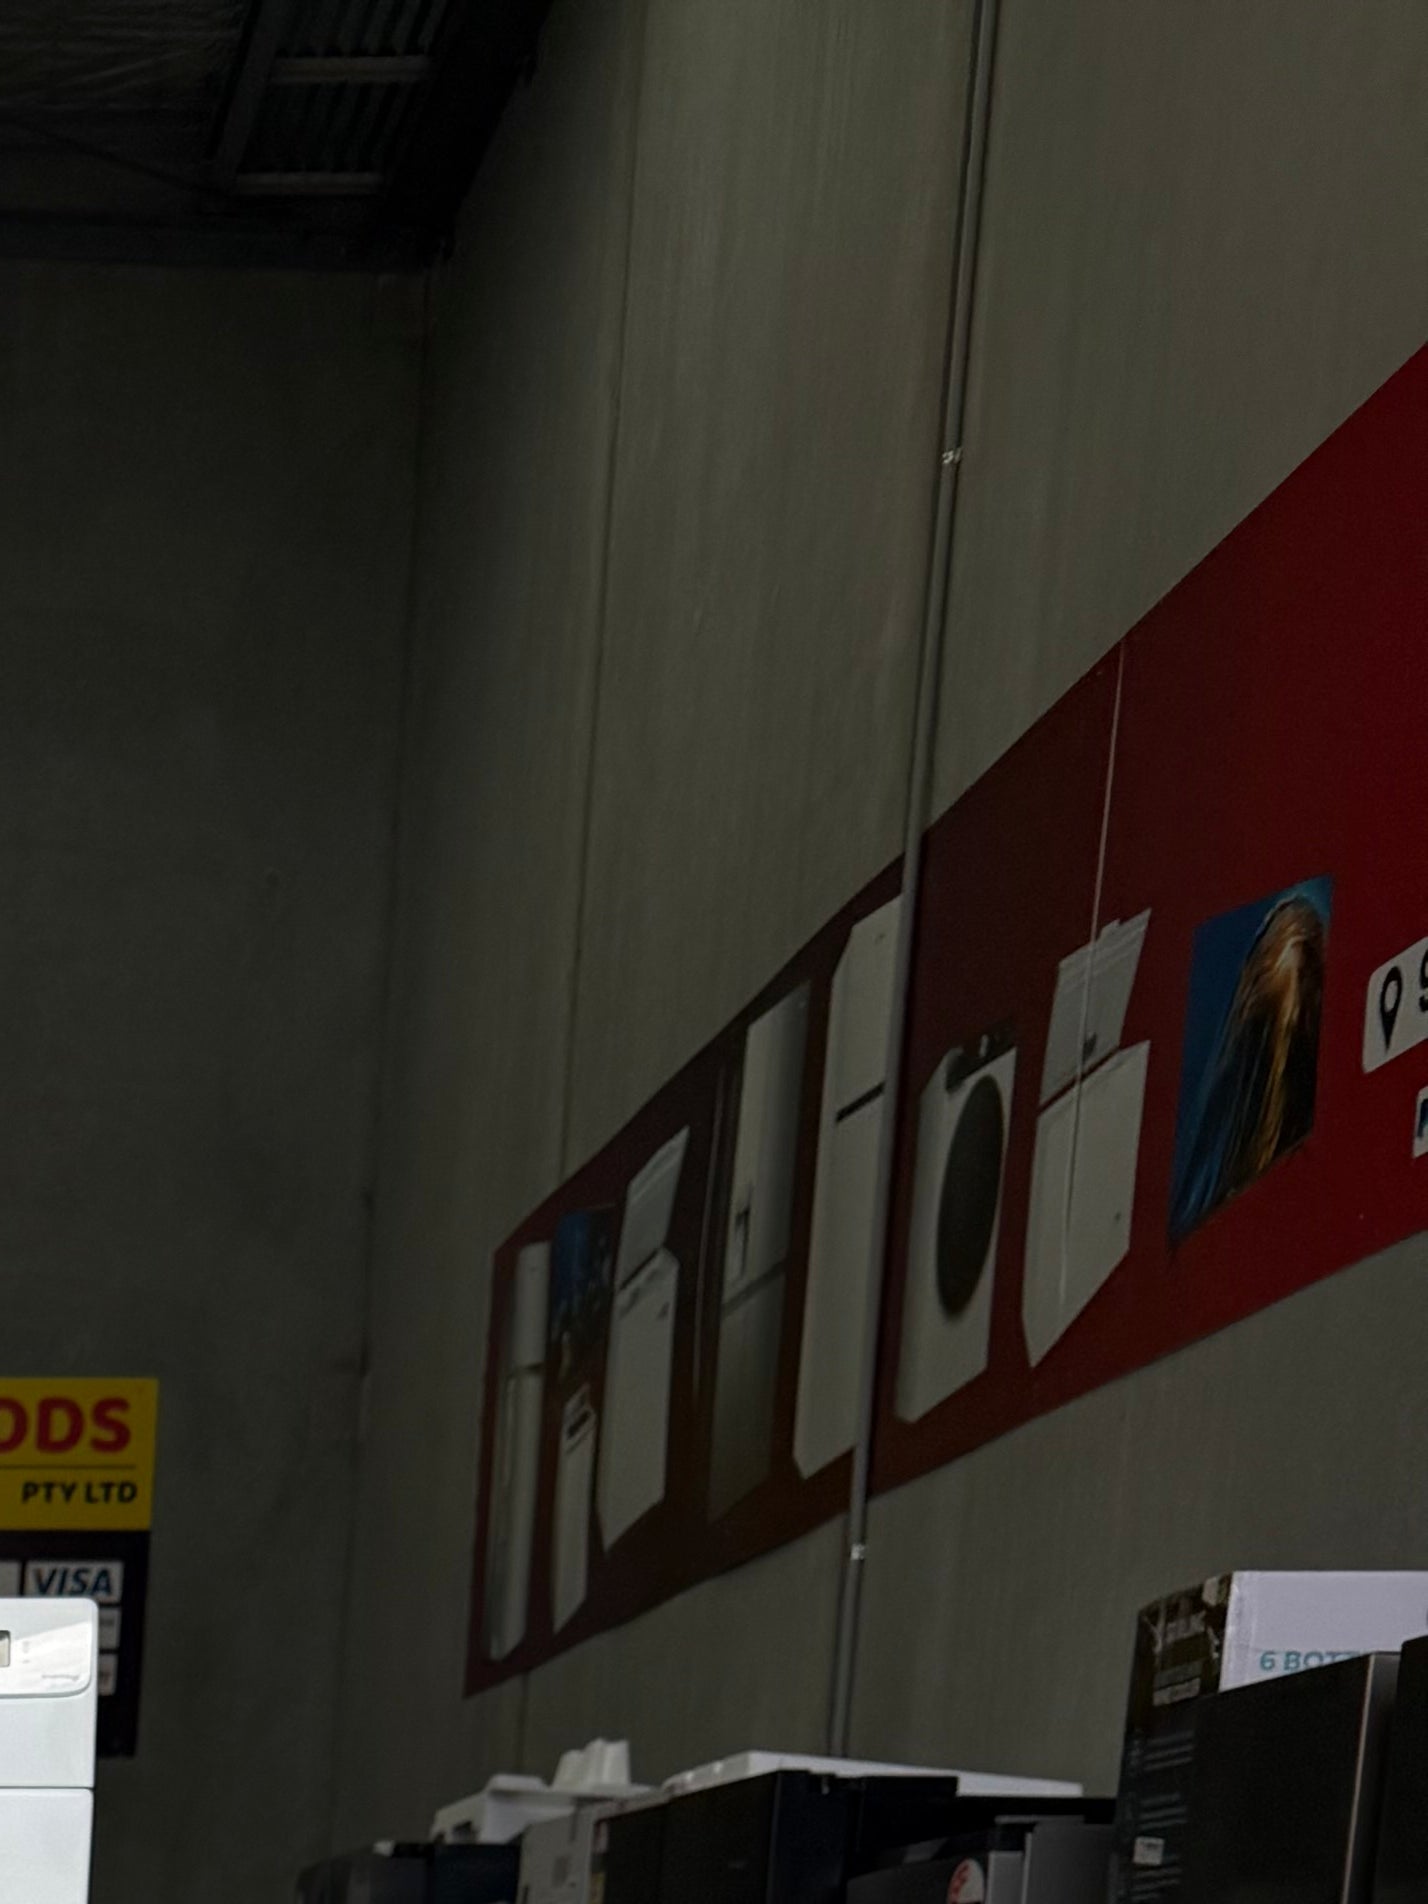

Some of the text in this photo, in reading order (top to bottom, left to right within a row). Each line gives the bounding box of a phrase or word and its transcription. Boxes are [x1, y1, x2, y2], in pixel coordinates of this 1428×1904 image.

[21, 1482, 137, 1503] PTY LTD
[33, 1569, 111, 1594] VISA
[1260, 1651, 1275, 1671] 6
